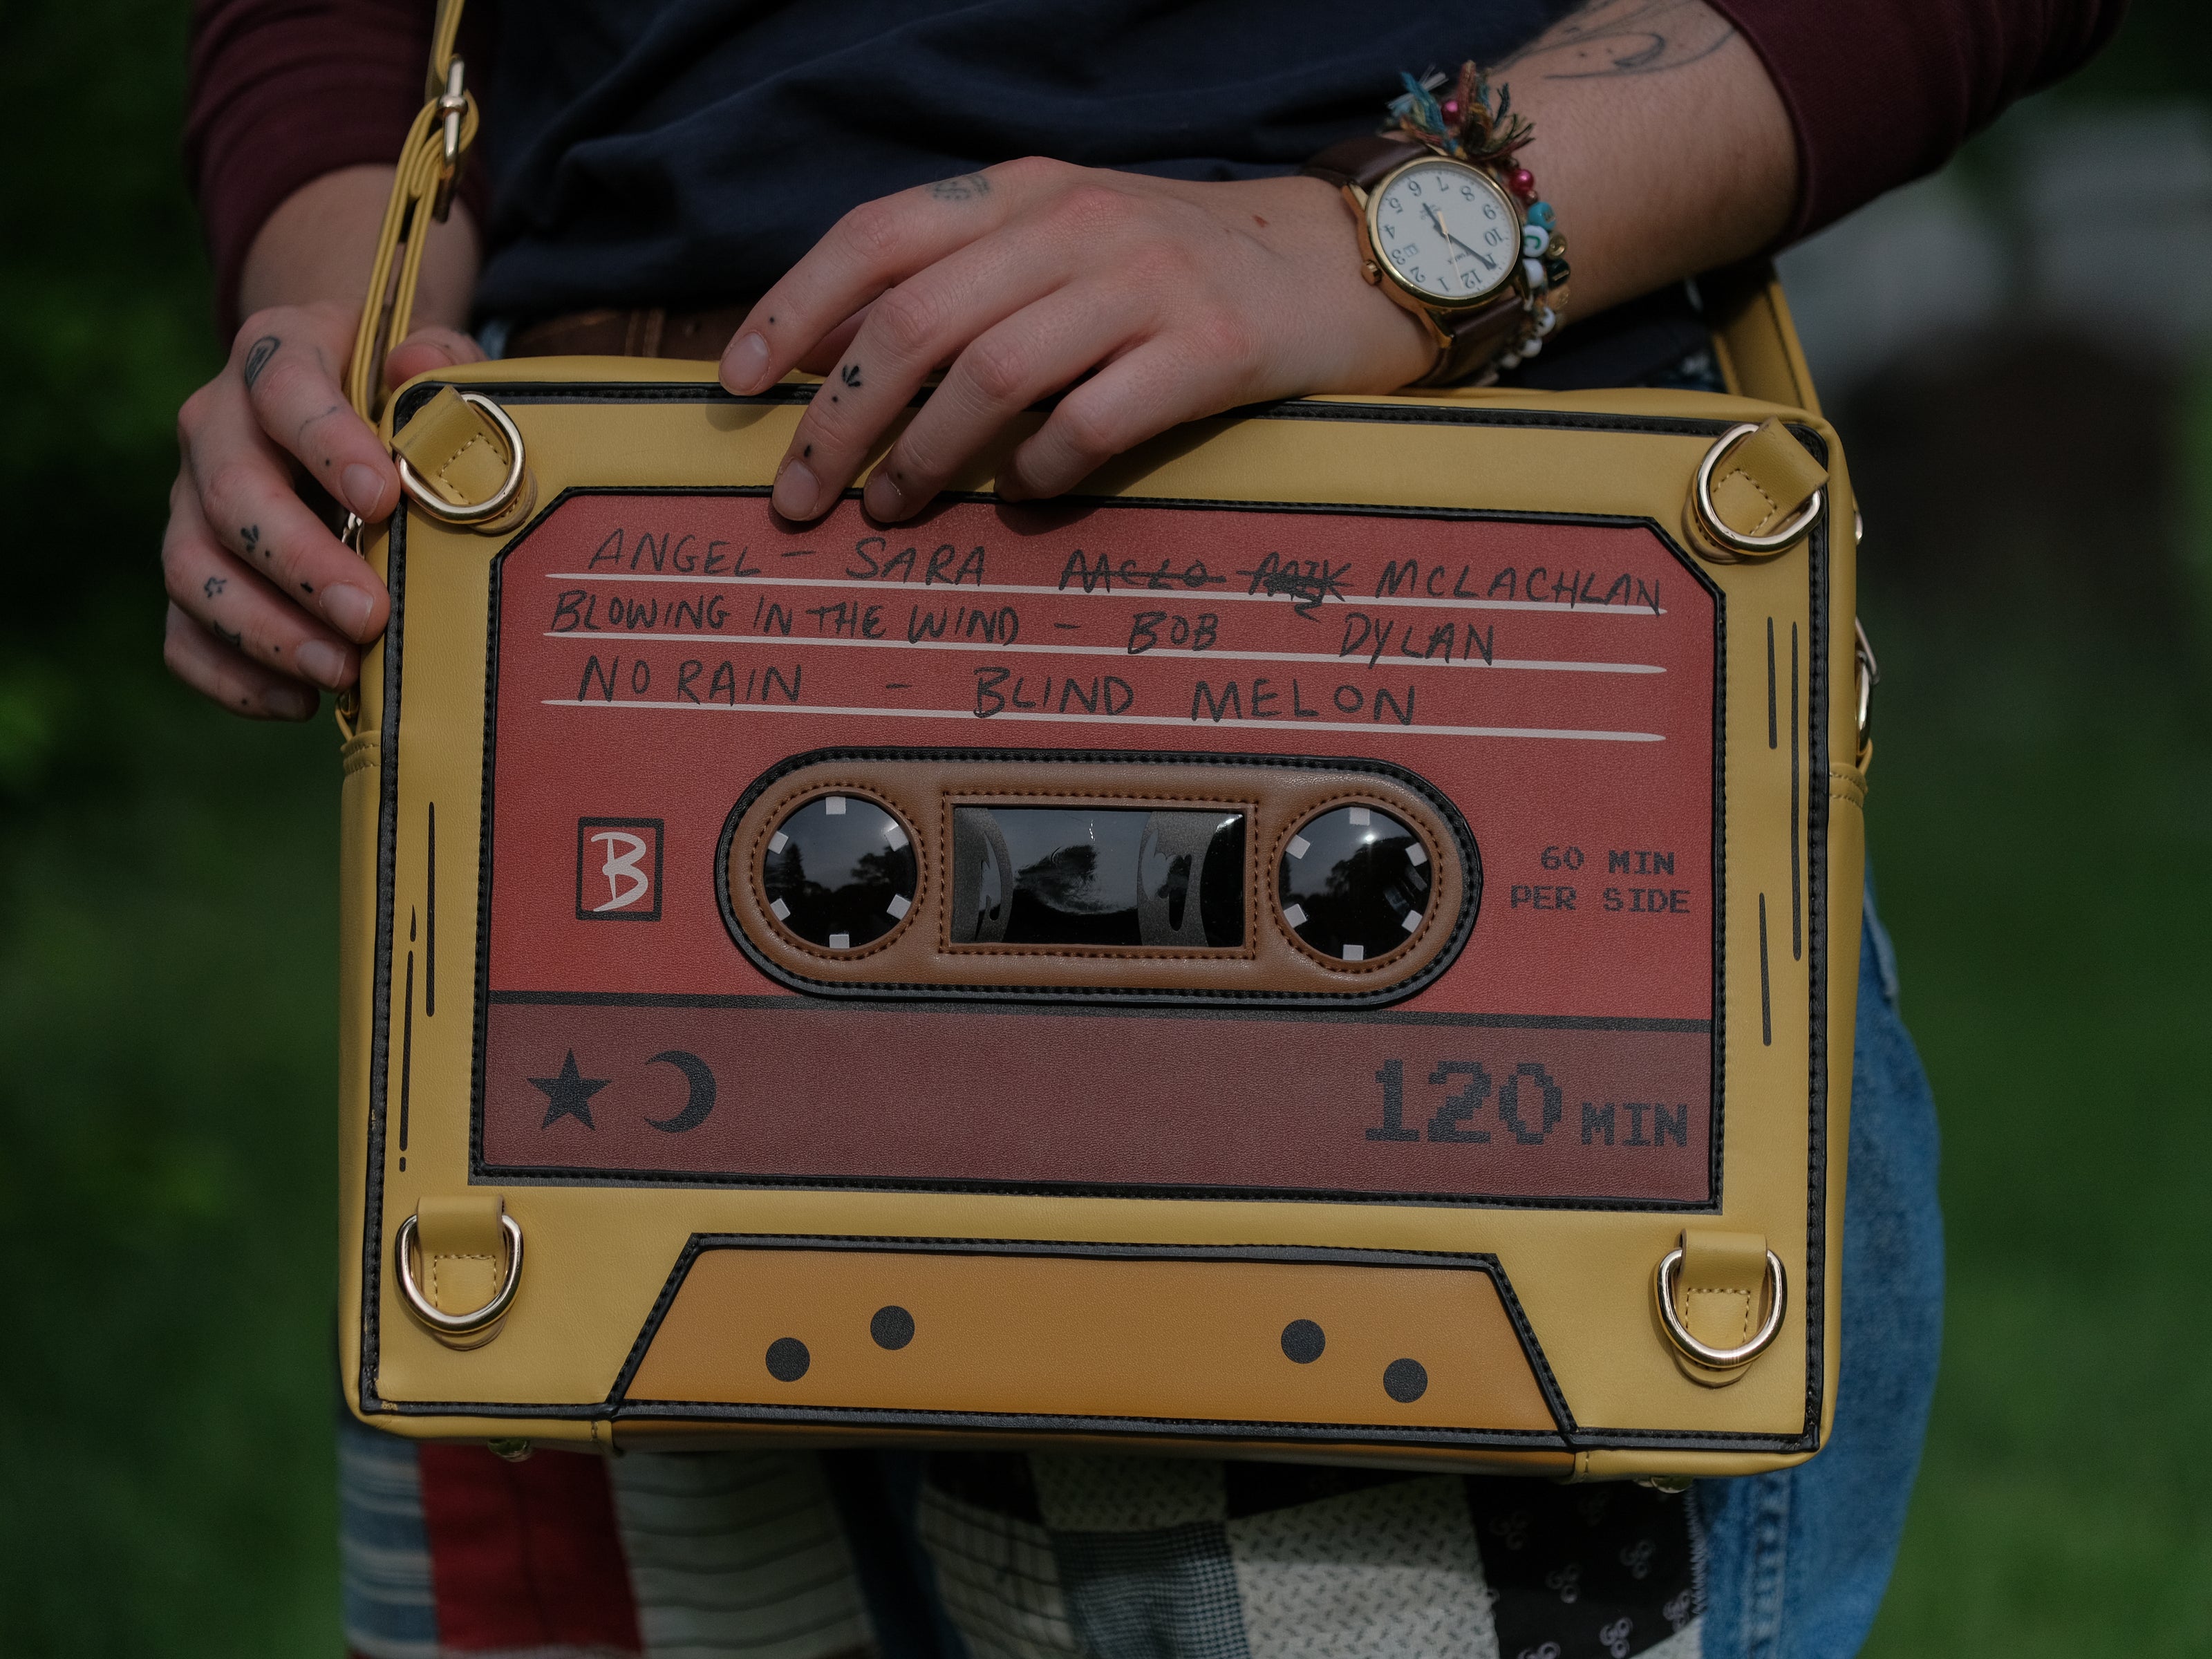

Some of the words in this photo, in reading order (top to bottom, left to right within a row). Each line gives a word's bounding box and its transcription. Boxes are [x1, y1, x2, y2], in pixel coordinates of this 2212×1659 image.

[1436, 176, 1450, 192] 7
[1460, 185, 1475, 202] 8
[1389, 197, 1403, 214] 5
[1385, 224, 1396, 239] 4
[1484, 227, 1503, 247] 10
[1391, 249, 1406, 265] 3
[1409, 267, 1426, 283] 2
[1438, 276, 1450, 292] 1
[1461, 269, 1482, 289] 12
[589, 529, 760, 577] ANGEL
[846, 537, 984, 585] SARA
[1376, 559, 1660, 617] MCLACHLAN
[552, 590, 729, 632] BLOWING
[754, 597, 791, 635] IN
[806, 602, 885, 639] THE
[908, 606, 1019, 645] WIND
[1128, 612, 1218, 654] BOB
[1340, 612, 1493, 669] DYLAN
[578, 655, 650, 701] NO
[678, 660, 801, 705] RAIN
[974, 667, 1133, 718] BLIND
[1191, 679, 1414, 725] MELON
[1541, 847, 1584, 870] 60
[1609, 851, 1674, 874] MIN
[591, 832, 648, 911] B
[1511, 886, 1575, 910] PER
[1604, 888, 1689, 912] SIDE
[1366, 1060, 1562, 1145] 120
[1582, 1103, 1686, 1145] MIN
